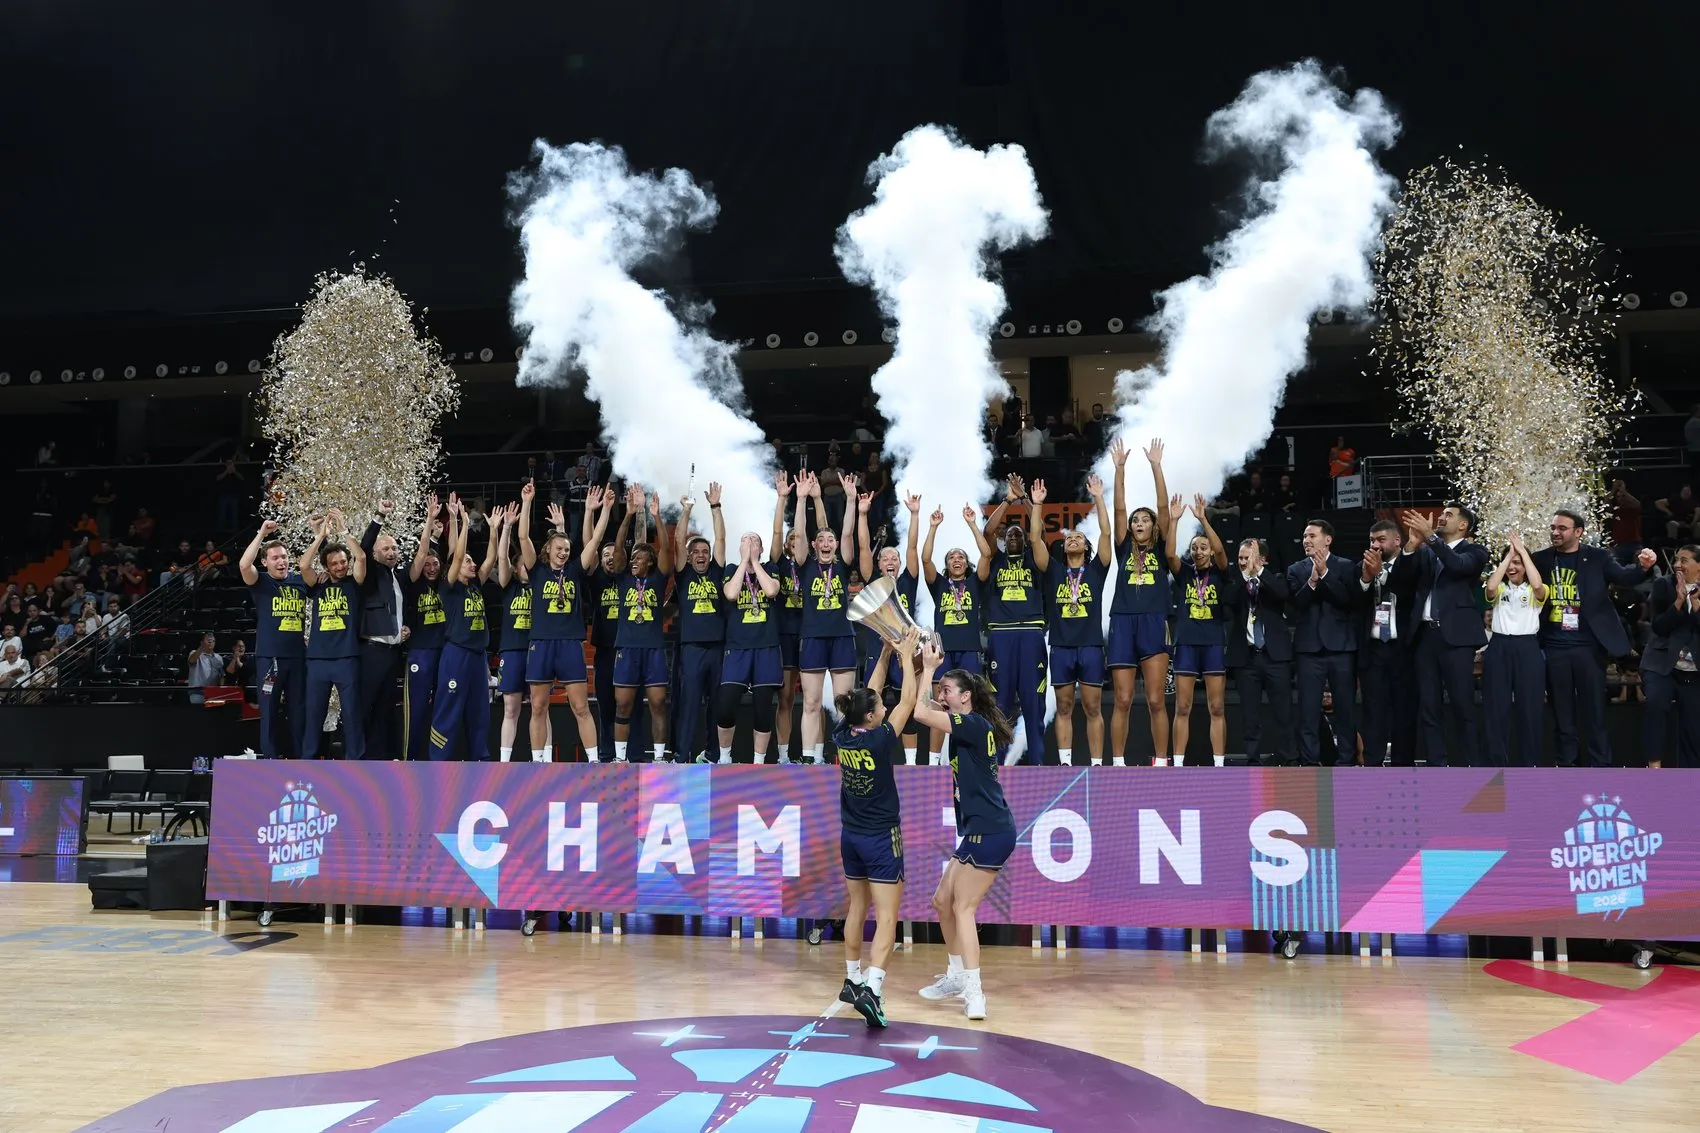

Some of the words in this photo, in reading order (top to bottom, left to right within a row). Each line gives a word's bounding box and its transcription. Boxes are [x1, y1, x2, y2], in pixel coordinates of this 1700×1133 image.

[997, 568, 1032, 582] CHAMPS
[257, 814, 337, 844] SUPERCUP
[457, 799, 1309, 887] CHAMONS
[268, 836, 324, 864] WOMEN
[1550, 832, 1663, 868] SUPERCUP
[1569, 860, 1647, 892] WOMEN
[1593, 891, 1627, 907] 2026
